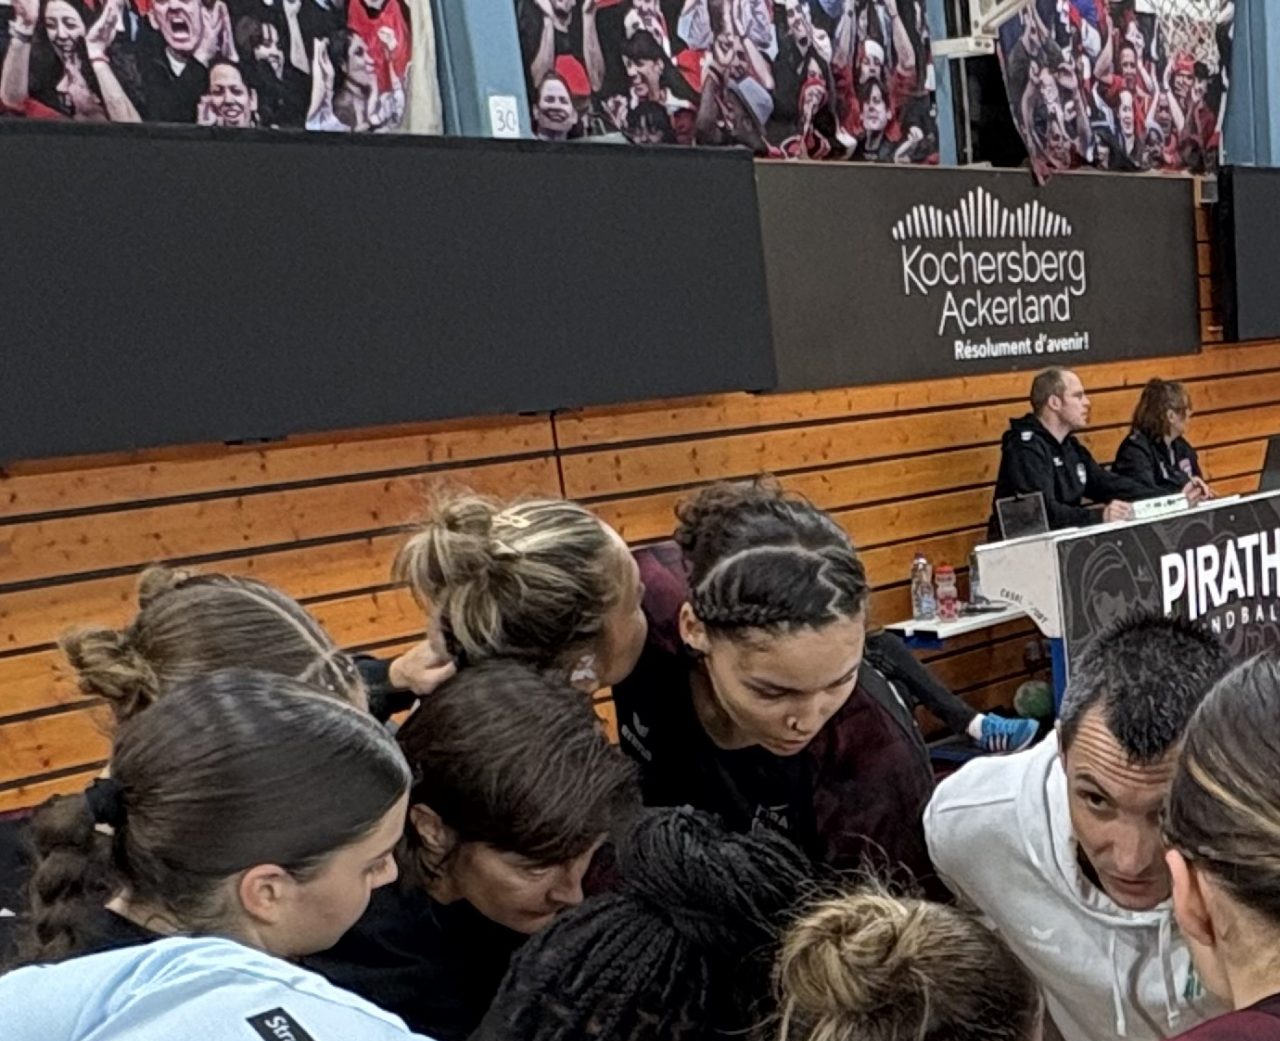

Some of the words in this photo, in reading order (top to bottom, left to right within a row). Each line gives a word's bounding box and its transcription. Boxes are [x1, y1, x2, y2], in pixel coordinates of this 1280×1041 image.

[901, 240, 1087, 296] Kochersberg
[938, 286, 1071, 336] Ackerland
[954, 337, 1033, 360] Résolument
